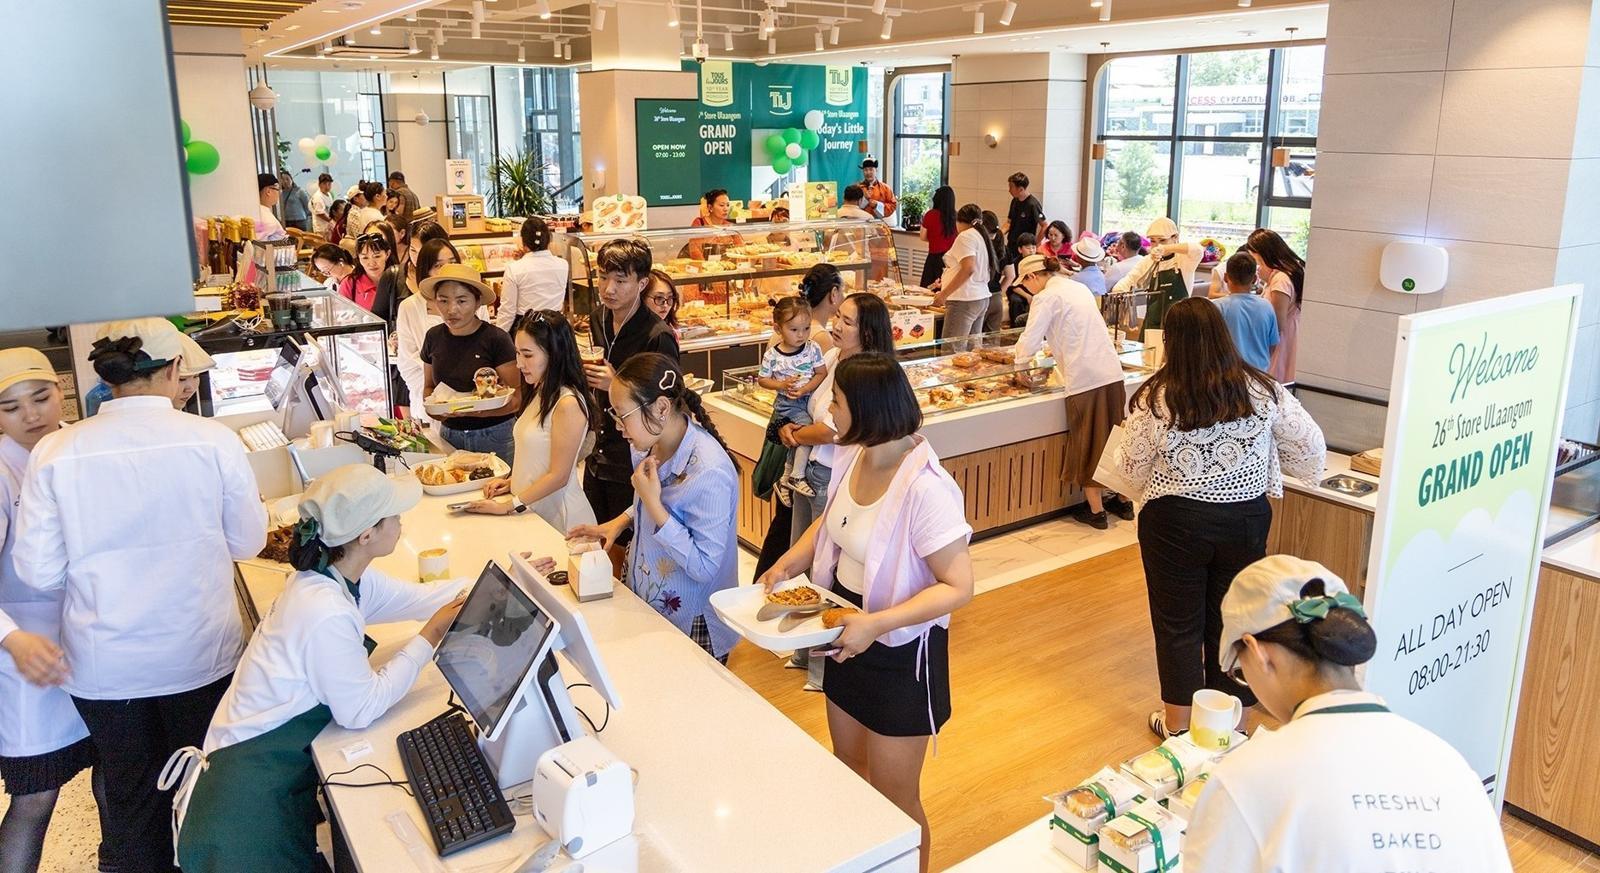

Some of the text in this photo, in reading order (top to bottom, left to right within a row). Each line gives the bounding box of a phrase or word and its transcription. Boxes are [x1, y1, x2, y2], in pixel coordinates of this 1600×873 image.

[829, 69, 850, 87] TLJ
[769, 91, 792, 111] TLJ
[704, 111, 717, 120] Store
[827, 110, 838, 118] Store
[699, 124, 737, 139] GRAND
[815, 122, 865, 137] oday's Little
[704, 141, 732, 155] OPEN
[823, 138, 854, 153] Journey
[1449, 331, 1539, 404] Welcome
[1432, 415, 1455, 449] 26th
[1455, 413, 1482, 441] Store
[1418, 430, 1534, 508] GRAND OPEN
[1393, 576, 1513, 662] ALL DAY OPEN
[1408, 629, 1491, 696] 08:00-21:30
[1352, 794, 1441, 812] FRESHLY
[1371, 832, 1441, 850] BAKED
